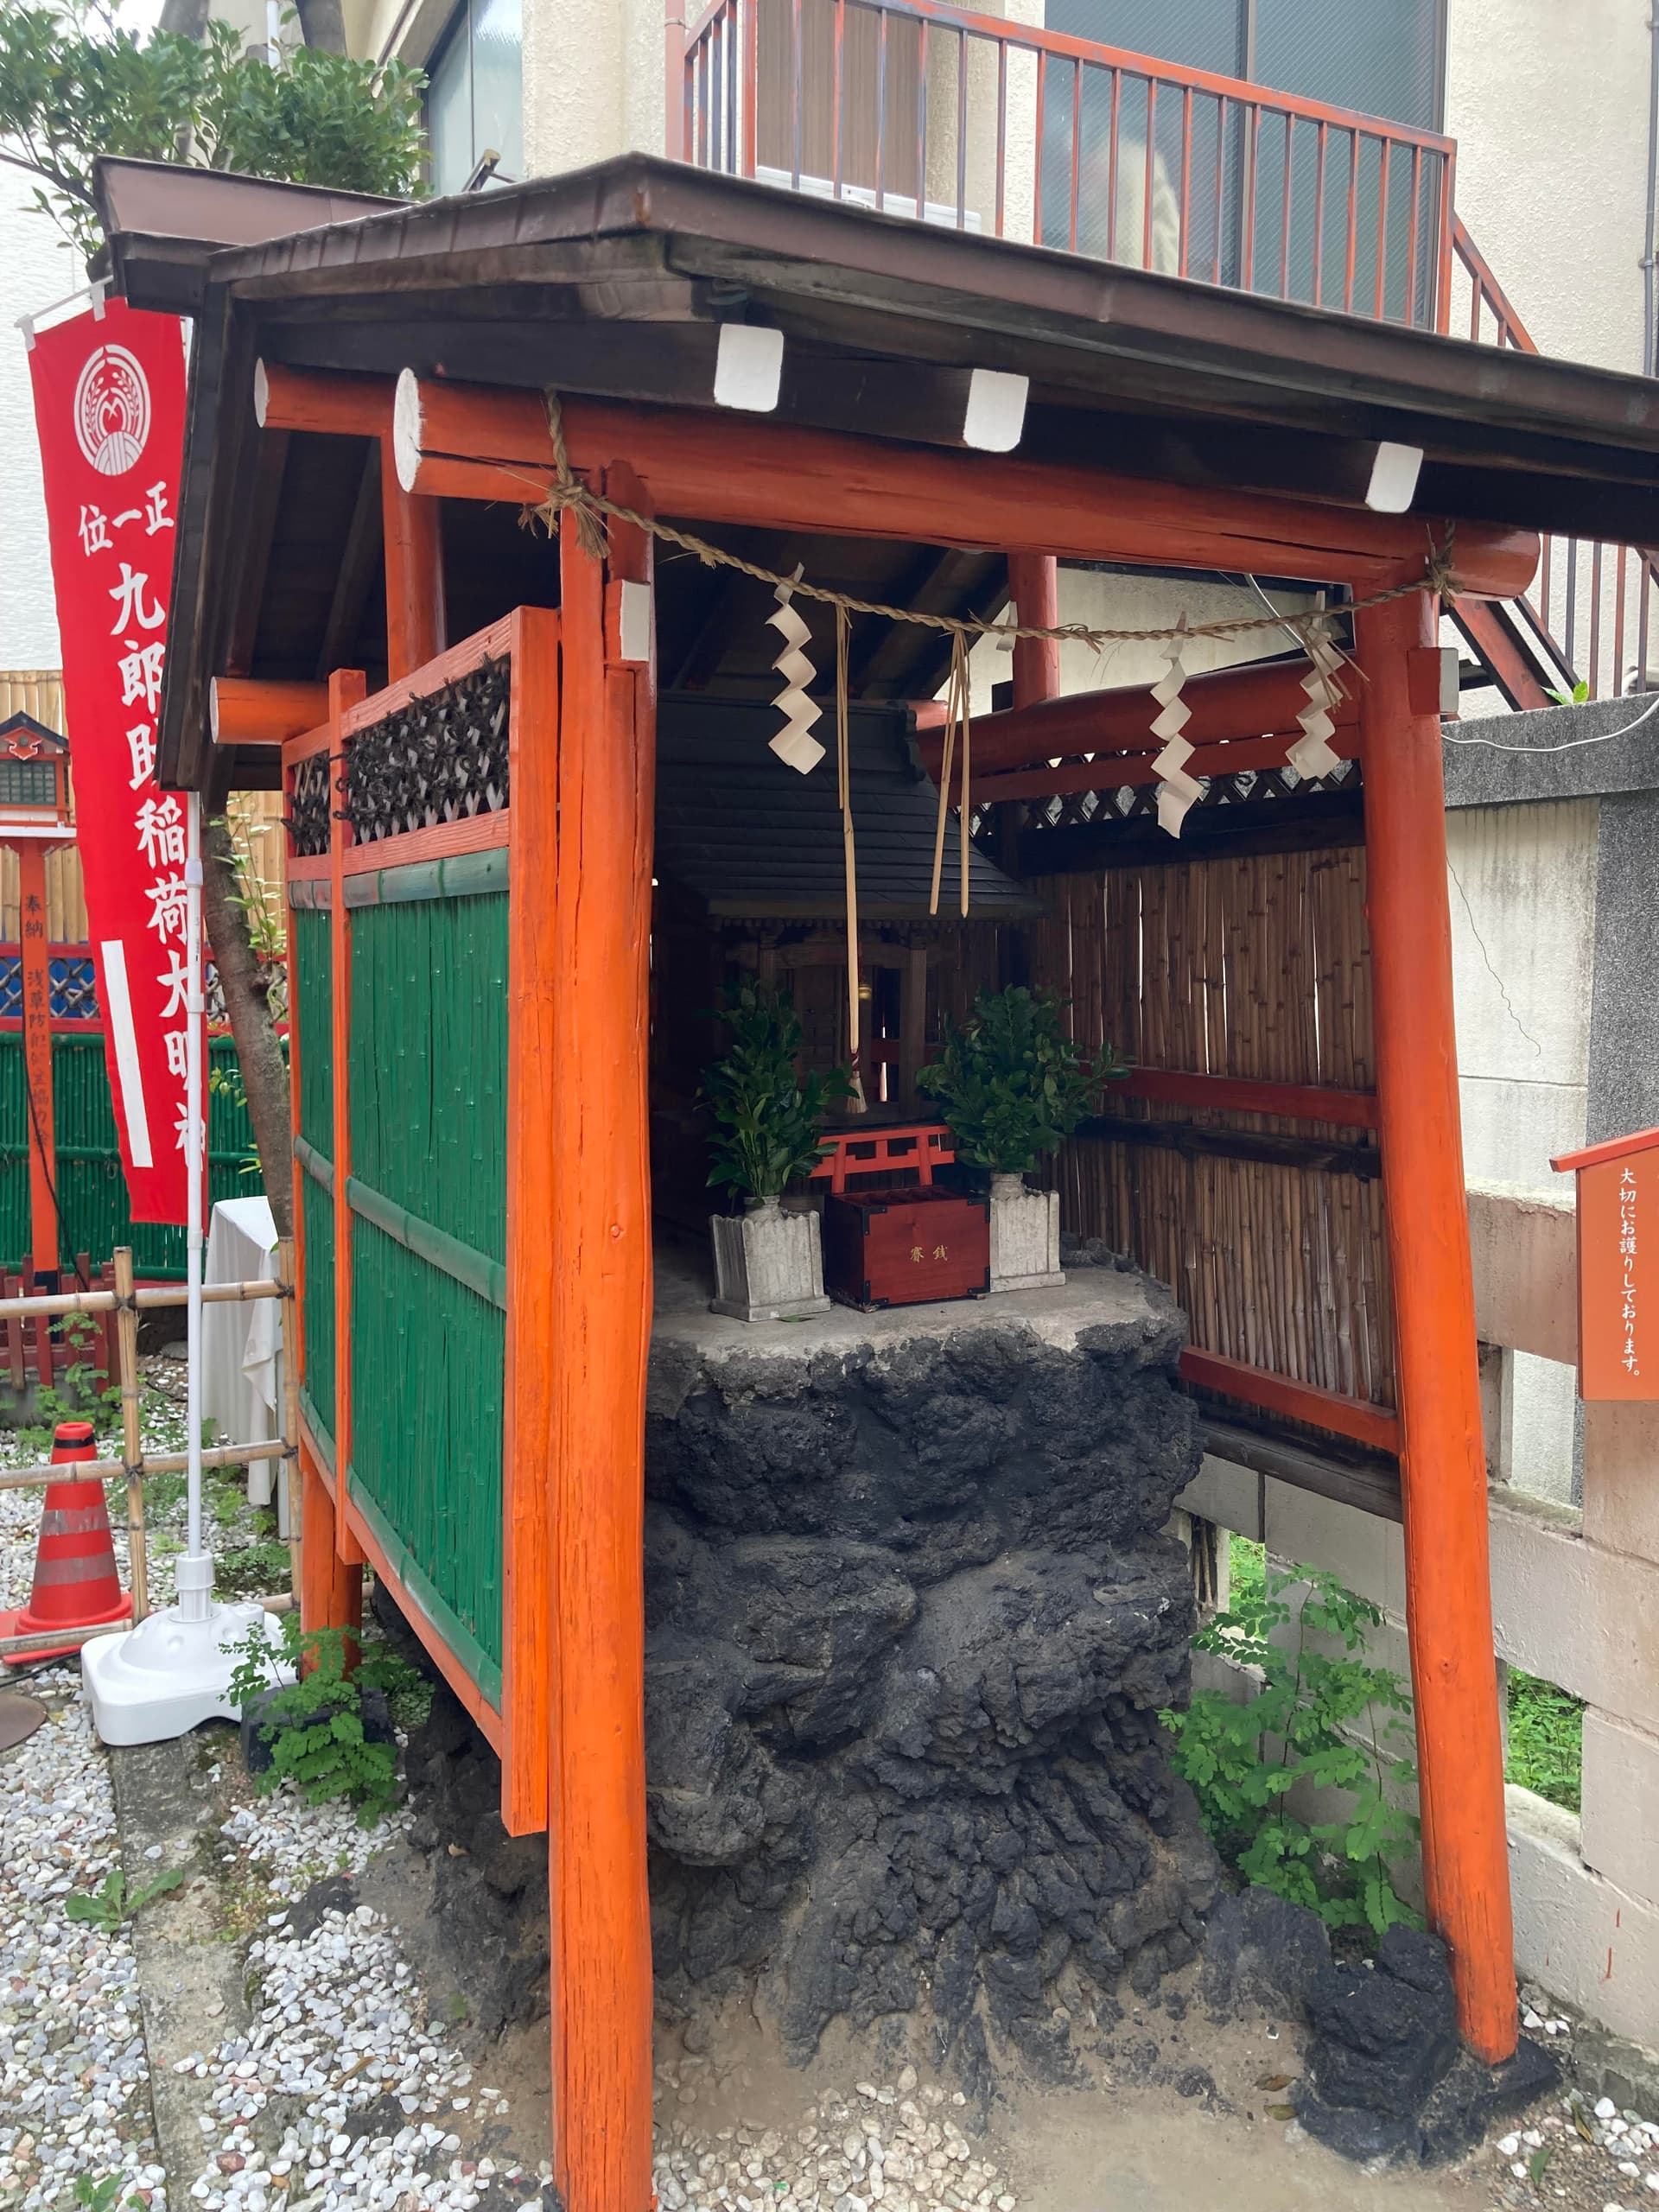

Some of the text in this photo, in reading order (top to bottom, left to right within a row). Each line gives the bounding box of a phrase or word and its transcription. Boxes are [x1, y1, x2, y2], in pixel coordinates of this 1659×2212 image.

[1618, 1167, 1640, 1376] 大切にお護りしております。
